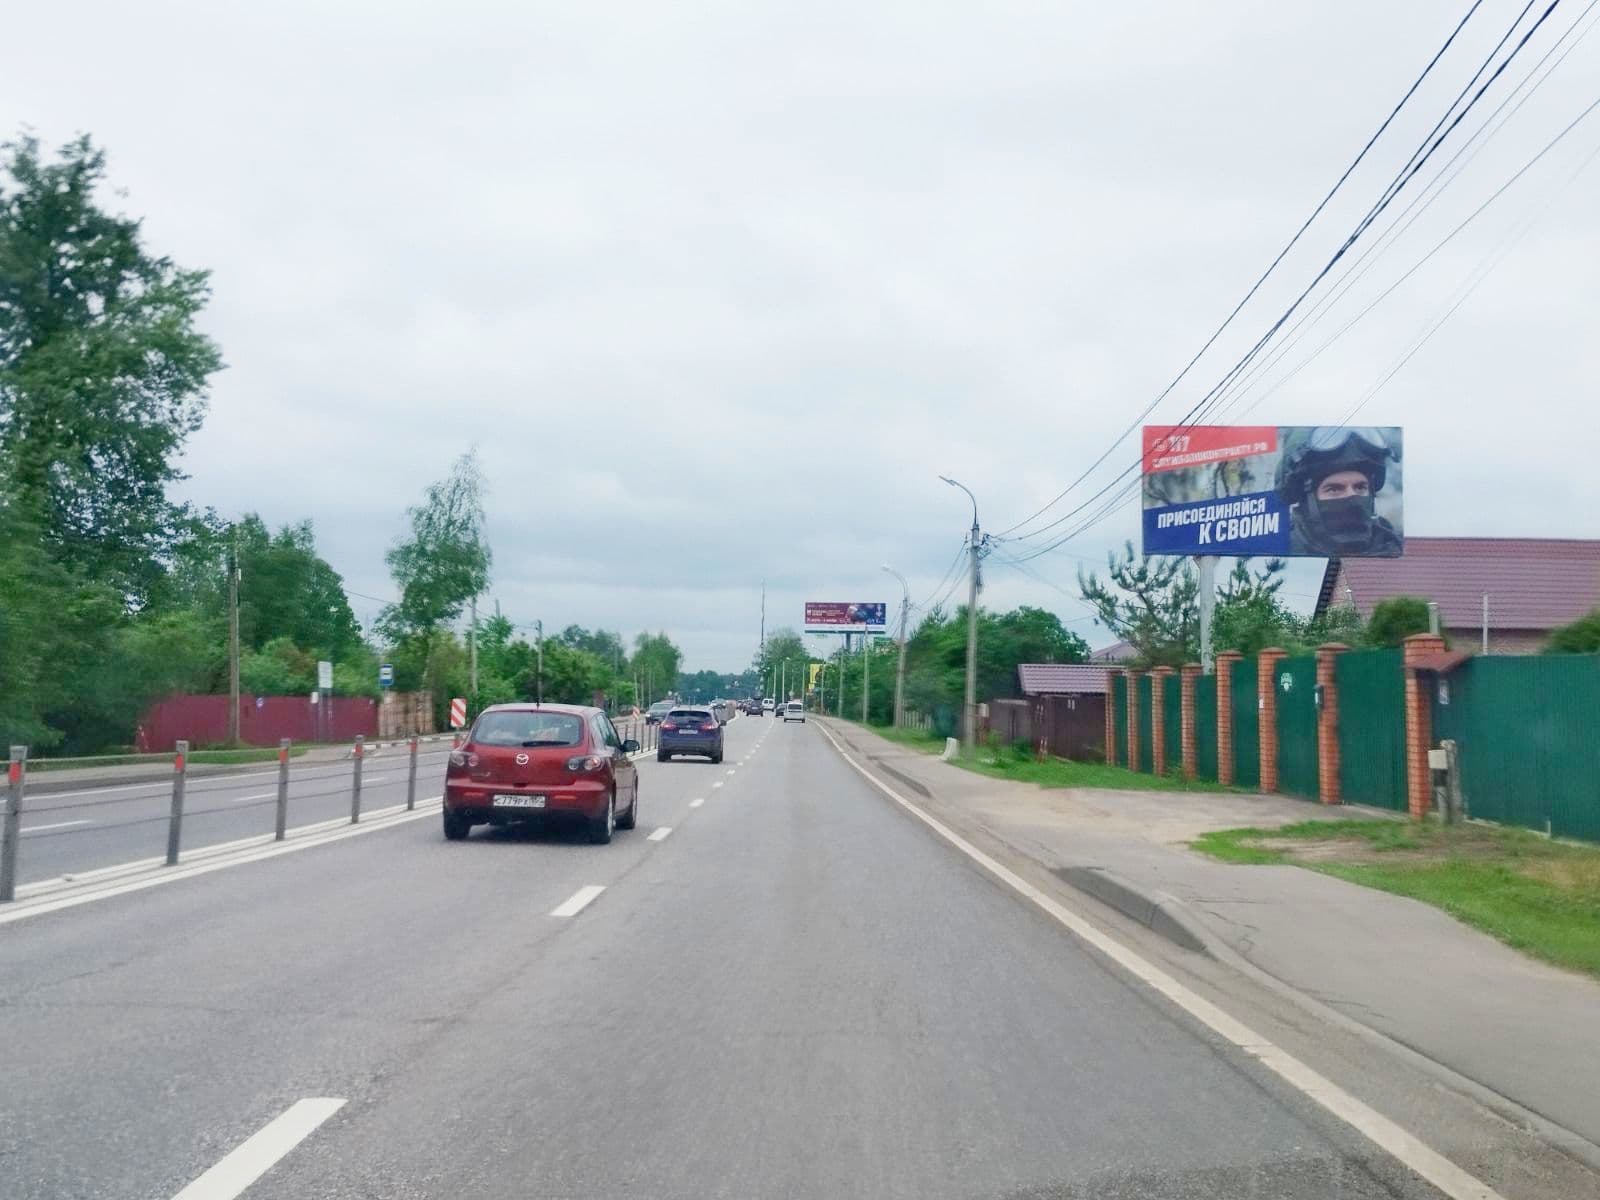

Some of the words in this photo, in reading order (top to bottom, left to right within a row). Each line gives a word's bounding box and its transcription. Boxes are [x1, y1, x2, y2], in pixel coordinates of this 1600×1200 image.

[1158, 497, 1265, 528] ПРИСОЕДИНЯЙСЯ
[1199, 522, 1212, 544] К
[1215, 512, 1280, 541] СВОИМ
